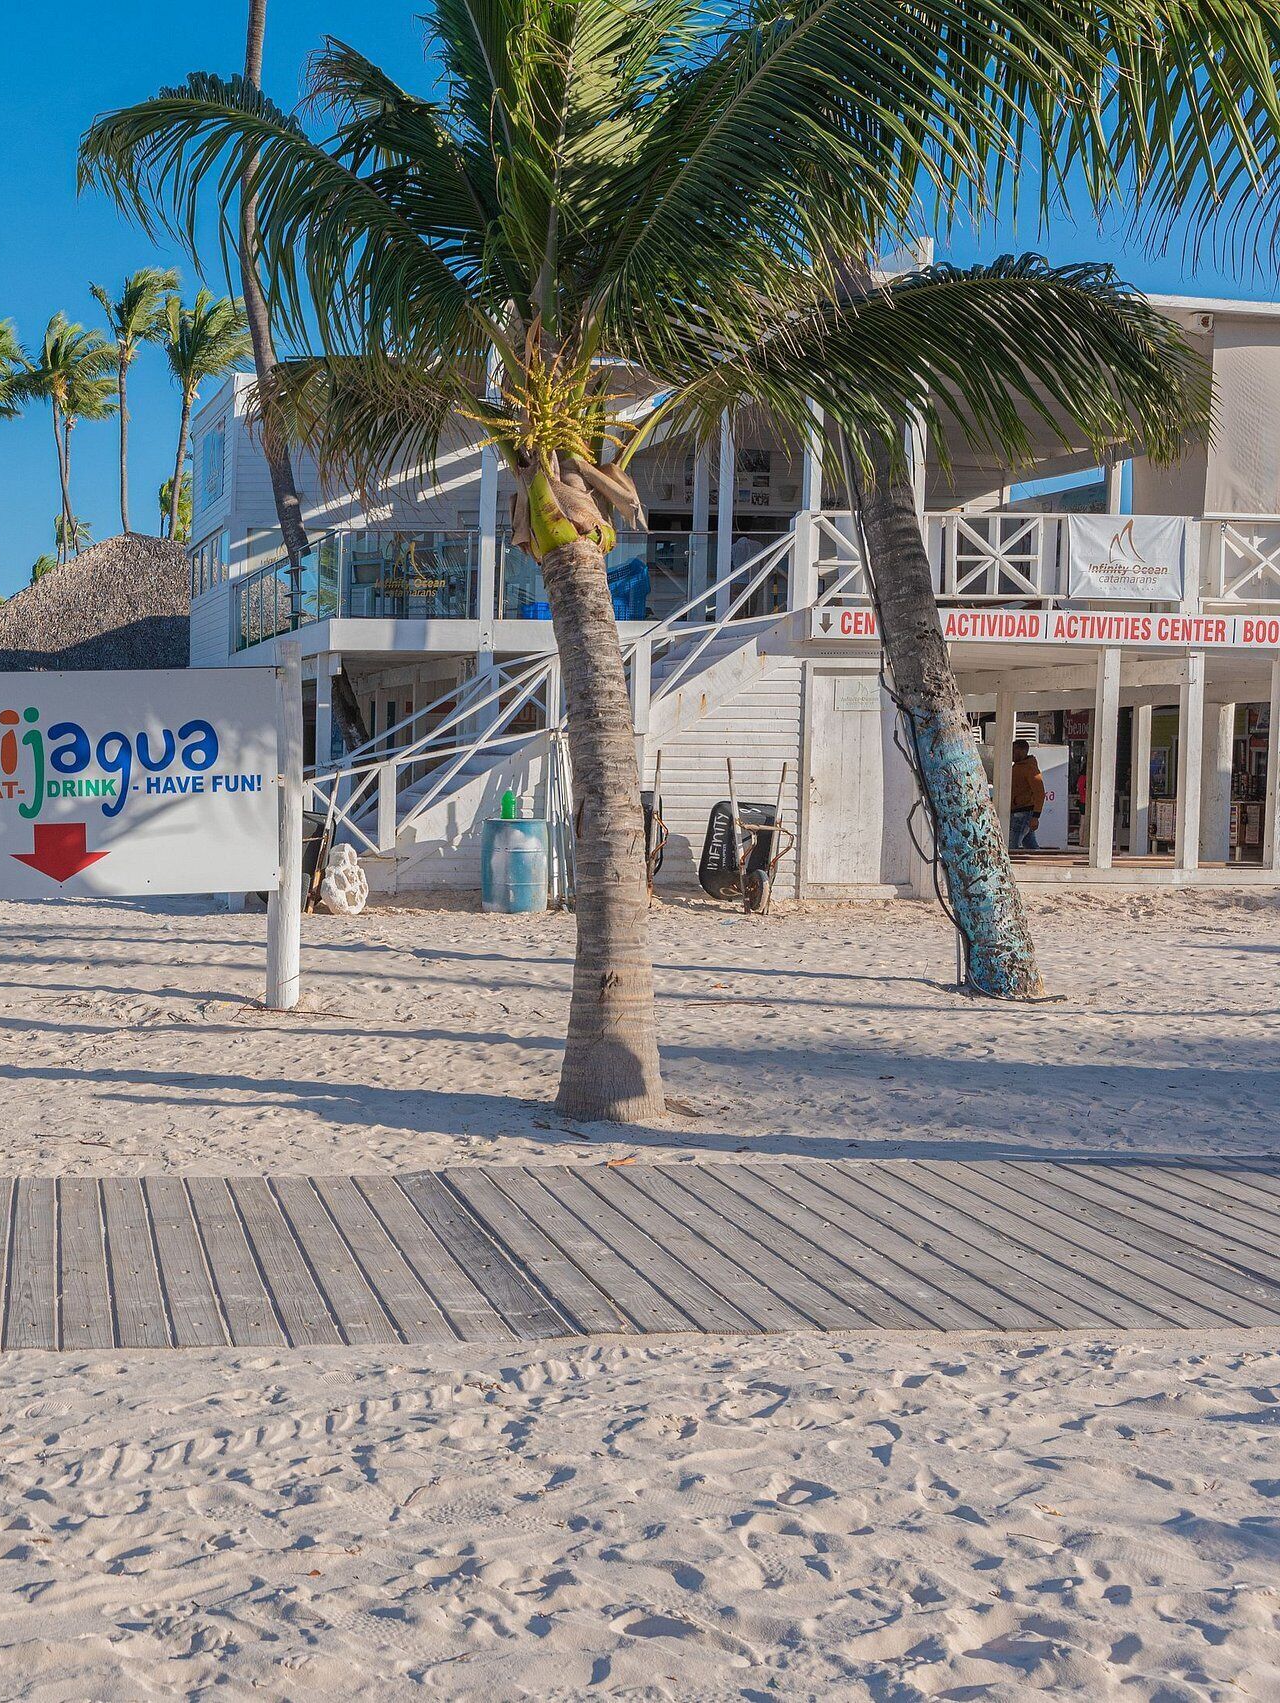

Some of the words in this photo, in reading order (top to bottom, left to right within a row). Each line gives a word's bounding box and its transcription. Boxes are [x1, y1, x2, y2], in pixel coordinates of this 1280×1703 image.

[1088, 563, 1128, 576] Infinity
[1132, 564, 1168, 575] Ocean
[413, 578, 446, 588] Ocean
[1098, 574, 1157, 584] catamarans
[945, 613, 1040, 638] ACTIVIDAD
[1054, 615, 1151, 641] ACTIVITIES
[1157, 617, 1226, 642] CENTER
[47, 778, 117, 798] DRINK
[145, 776, 205, 795] HAVE
[211, 774, 262, 793] FUN!
